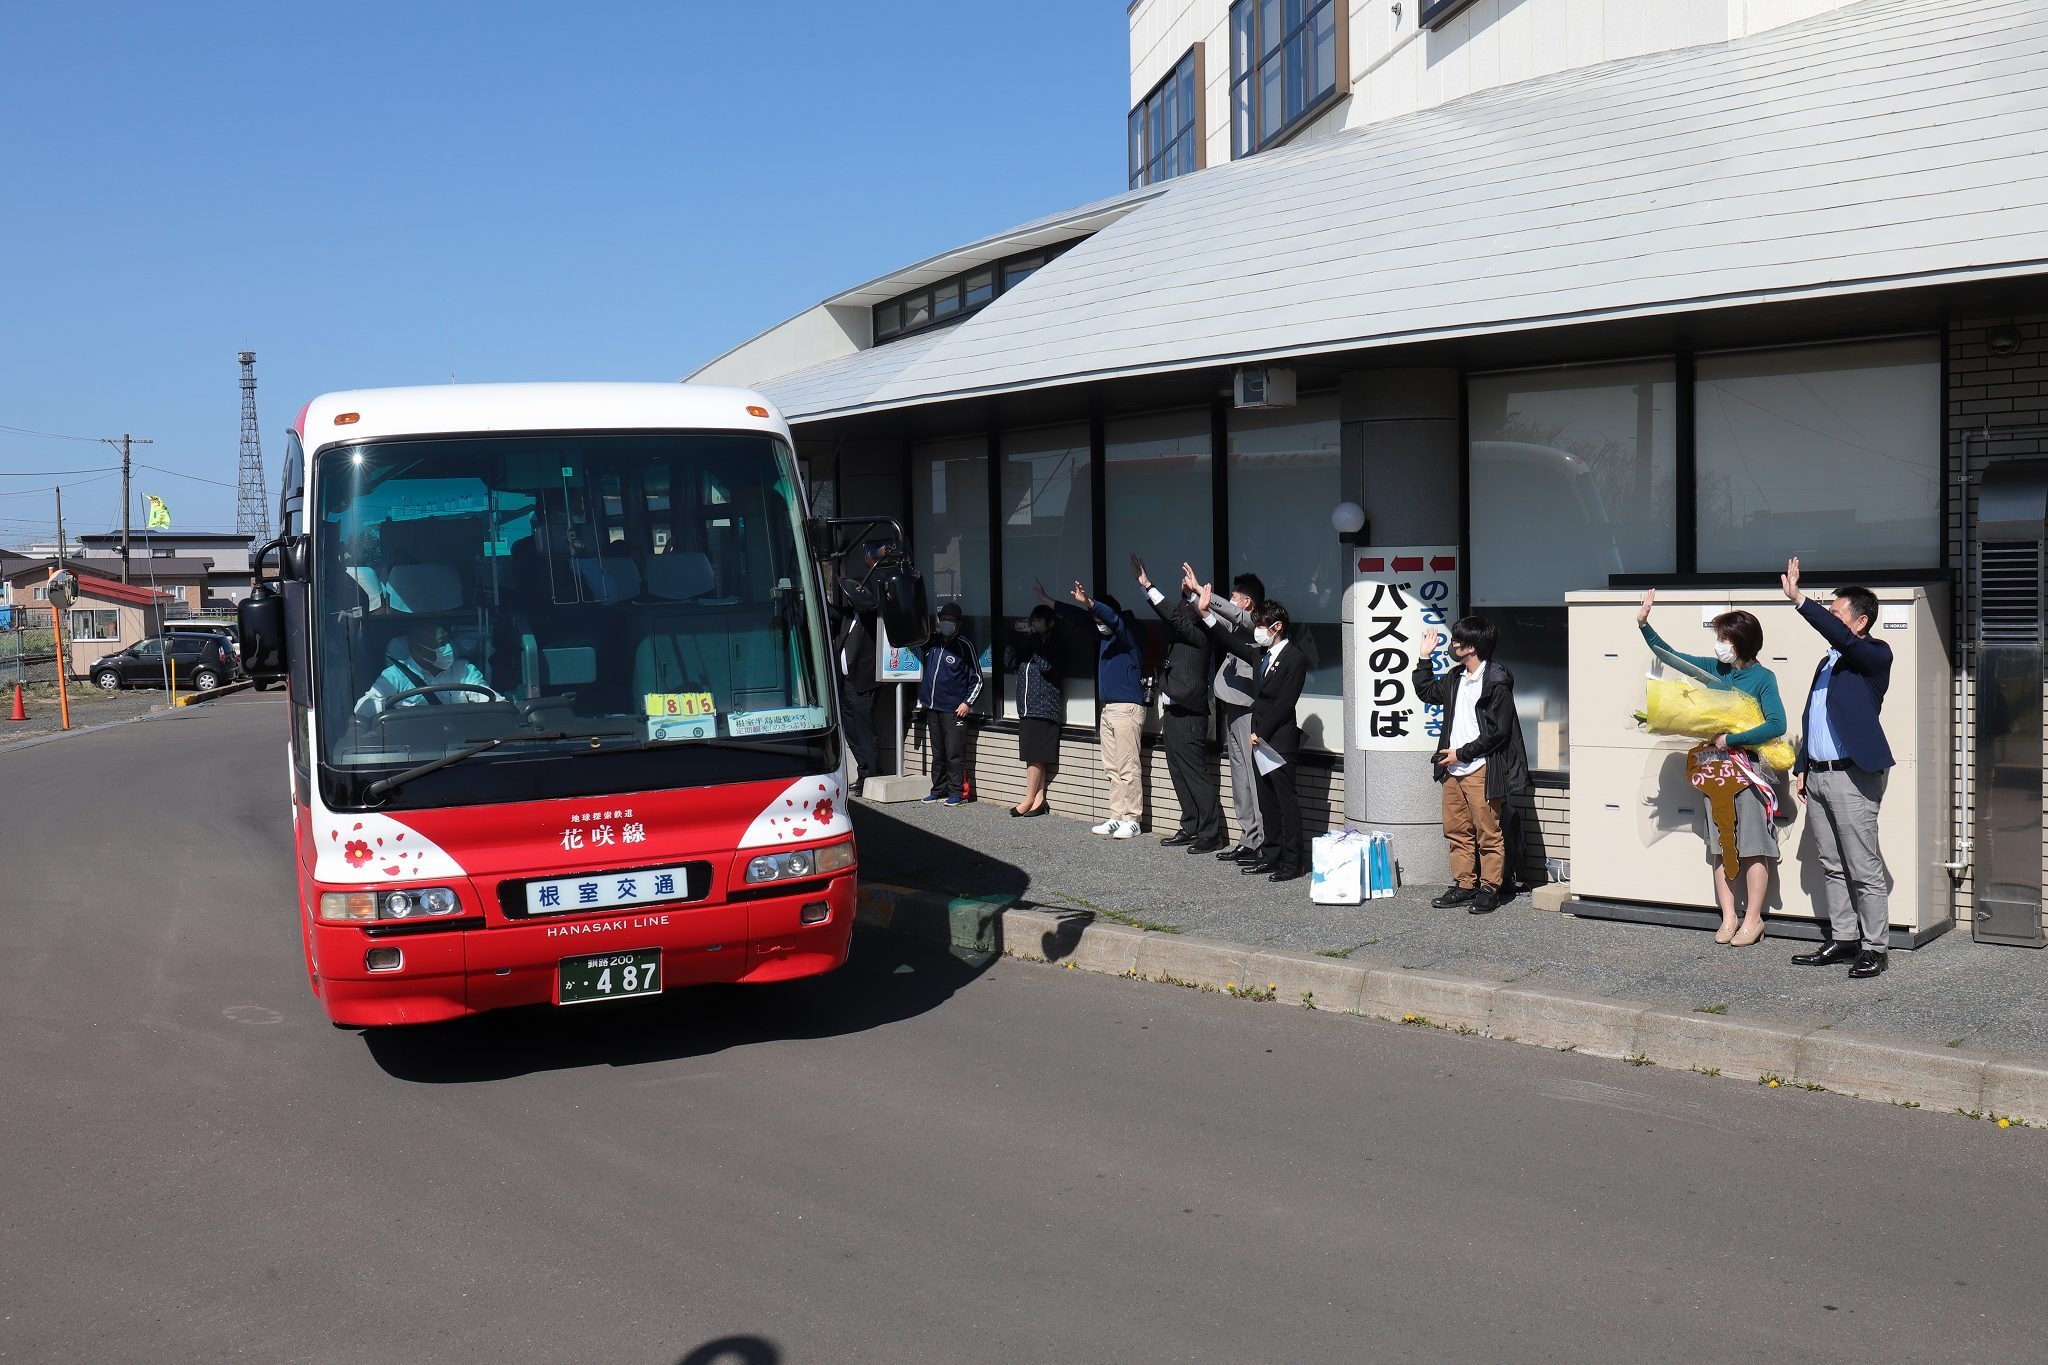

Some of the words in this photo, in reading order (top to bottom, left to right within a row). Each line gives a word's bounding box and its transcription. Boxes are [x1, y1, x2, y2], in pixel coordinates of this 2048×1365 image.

[1367, 582, 1414, 738] バスのりば
[1420, 580, 1450, 738] のさっぷゆき
[571, 809, 633, 822] 地球探索鉄道
[558, 822, 646, 850] 花咲線
[539, 874, 675, 907] 根室交通
[547, 920, 627, 937] HANASAKI
[634, 915, 670, 928] LINE
